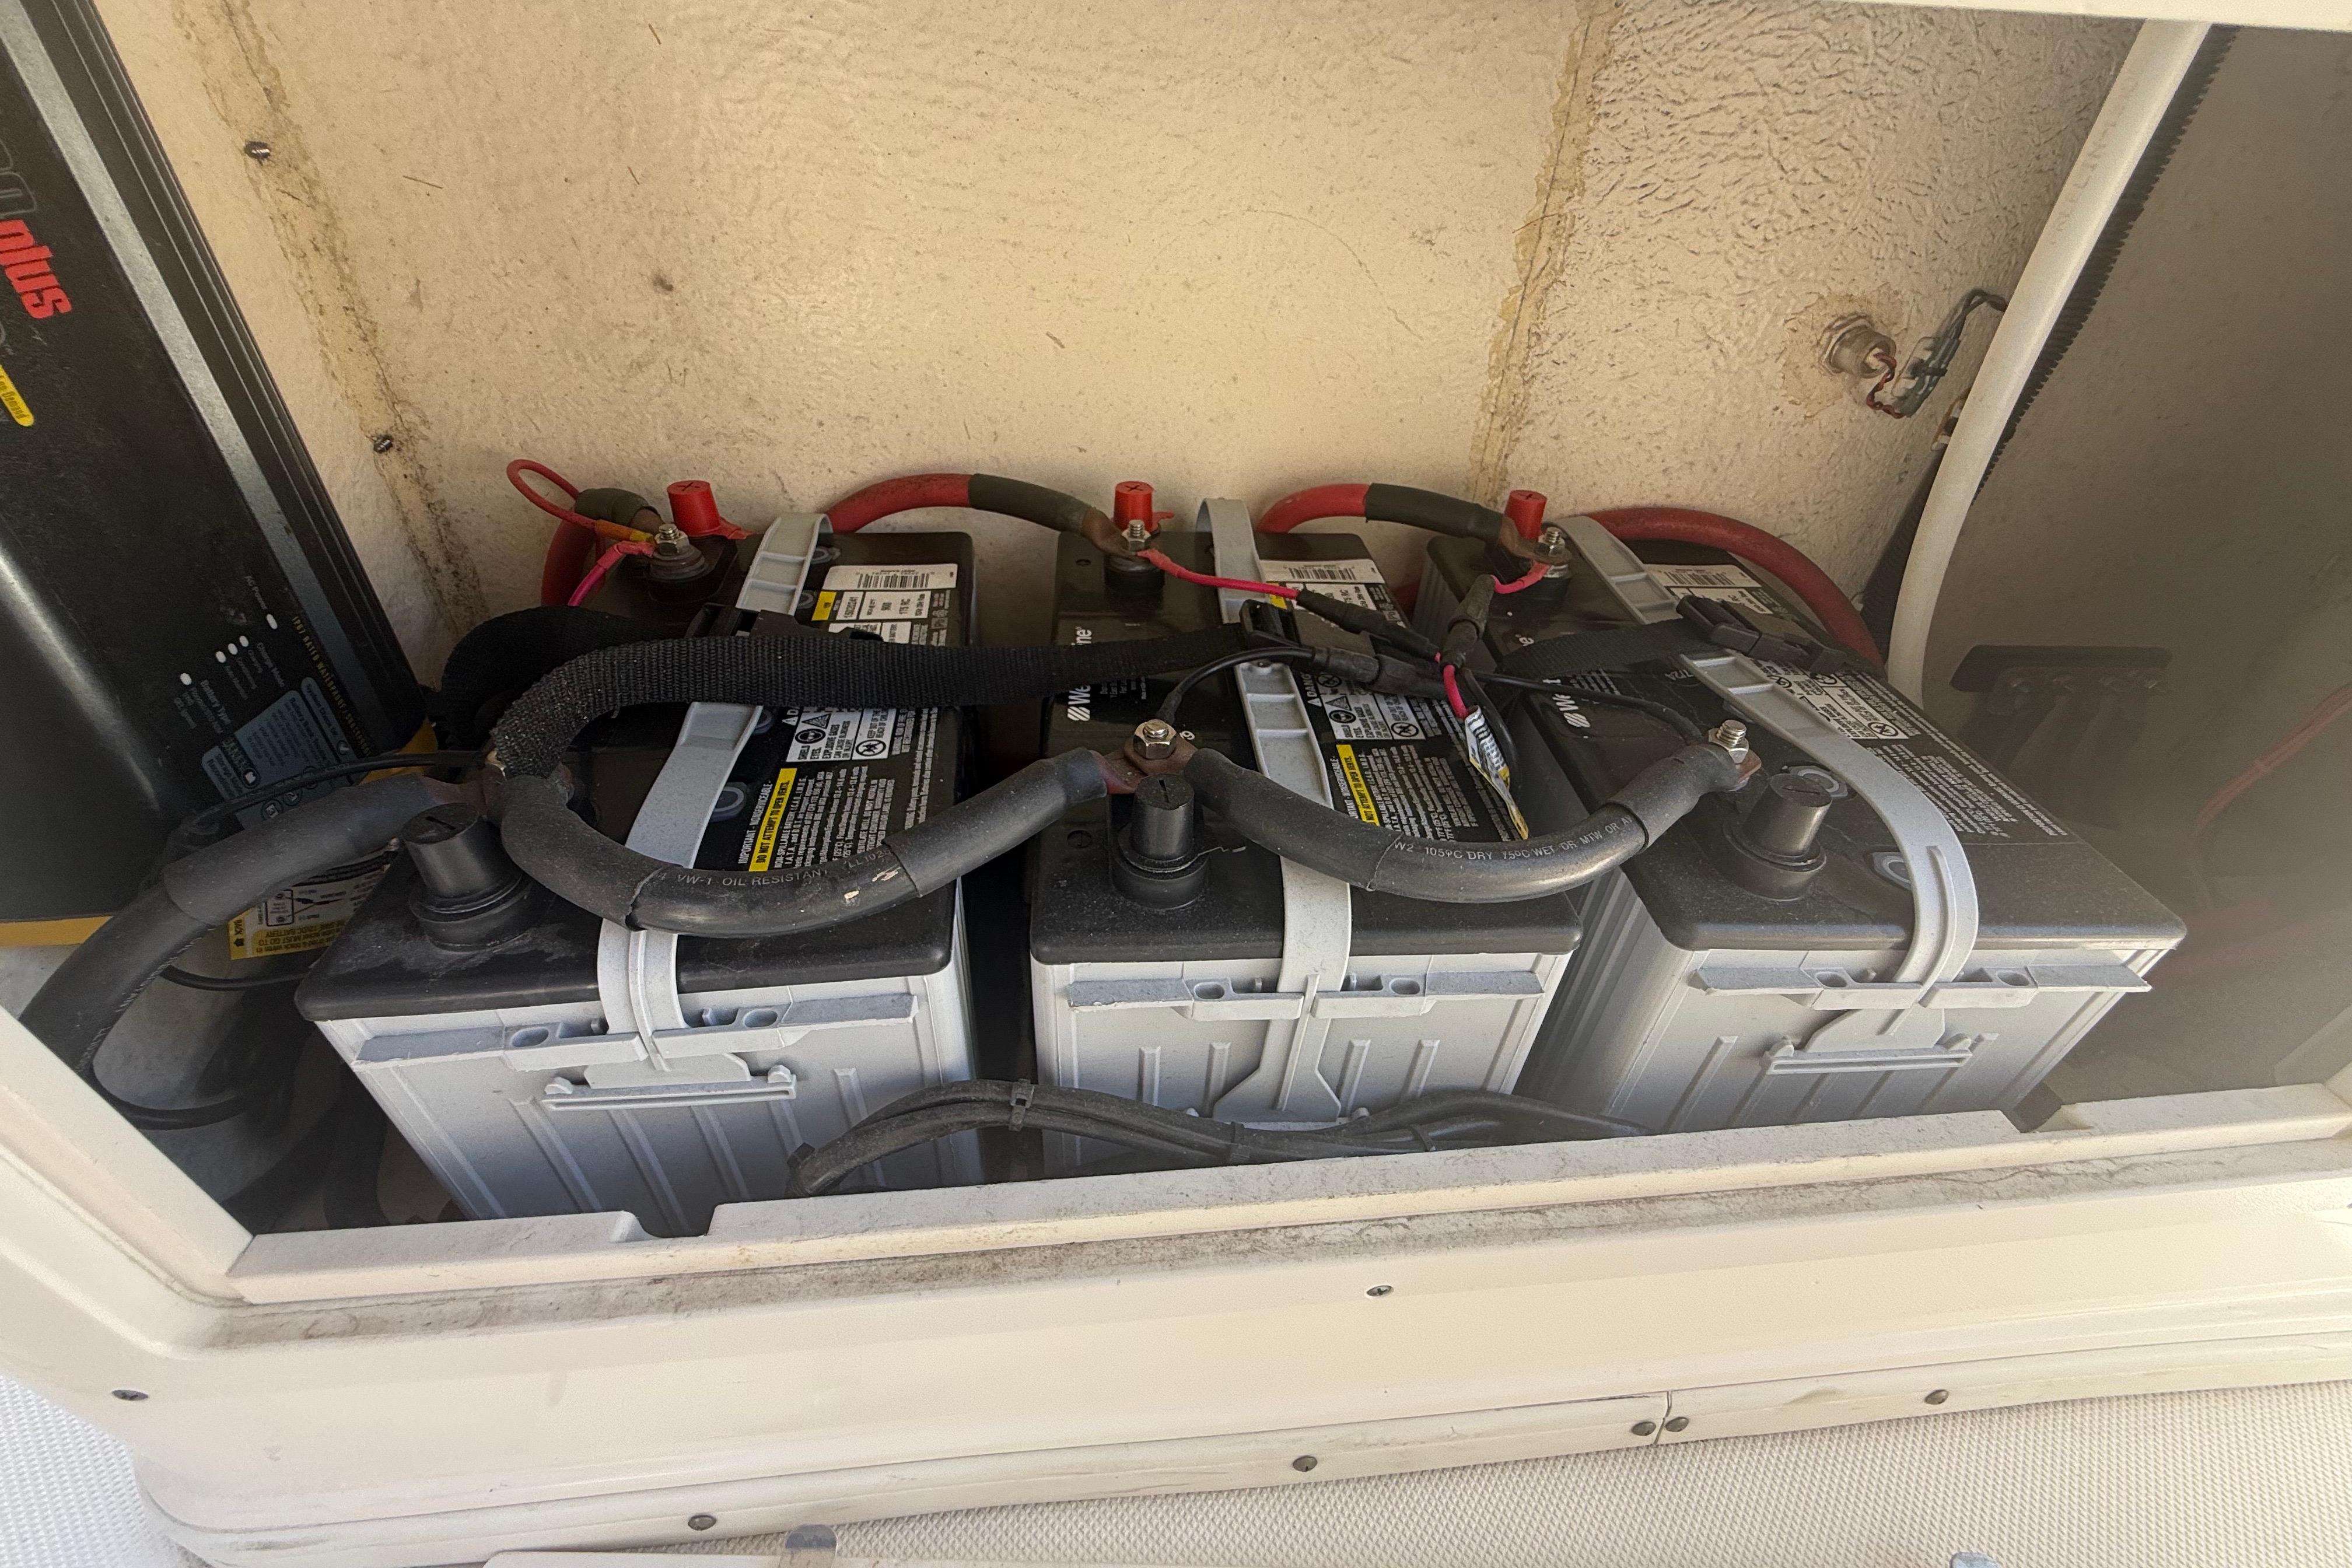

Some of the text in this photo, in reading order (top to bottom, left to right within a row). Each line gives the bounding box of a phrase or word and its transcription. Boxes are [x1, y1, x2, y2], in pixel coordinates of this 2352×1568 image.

[1068, 684, 1091, 705] We
[1466, 851, 1492, 860] DRY
[1532, 845, 1555, 857] WET
[1560, 840, 1577, 850] OR
[1580, 830, 1602, 845] MTW
[1605, 822, 1619, 834] OR
[678, 874, 712, 885] VW-1
[722, 877, 746, 886] OIL
[752, 869, 828, 886] RESISTAN
